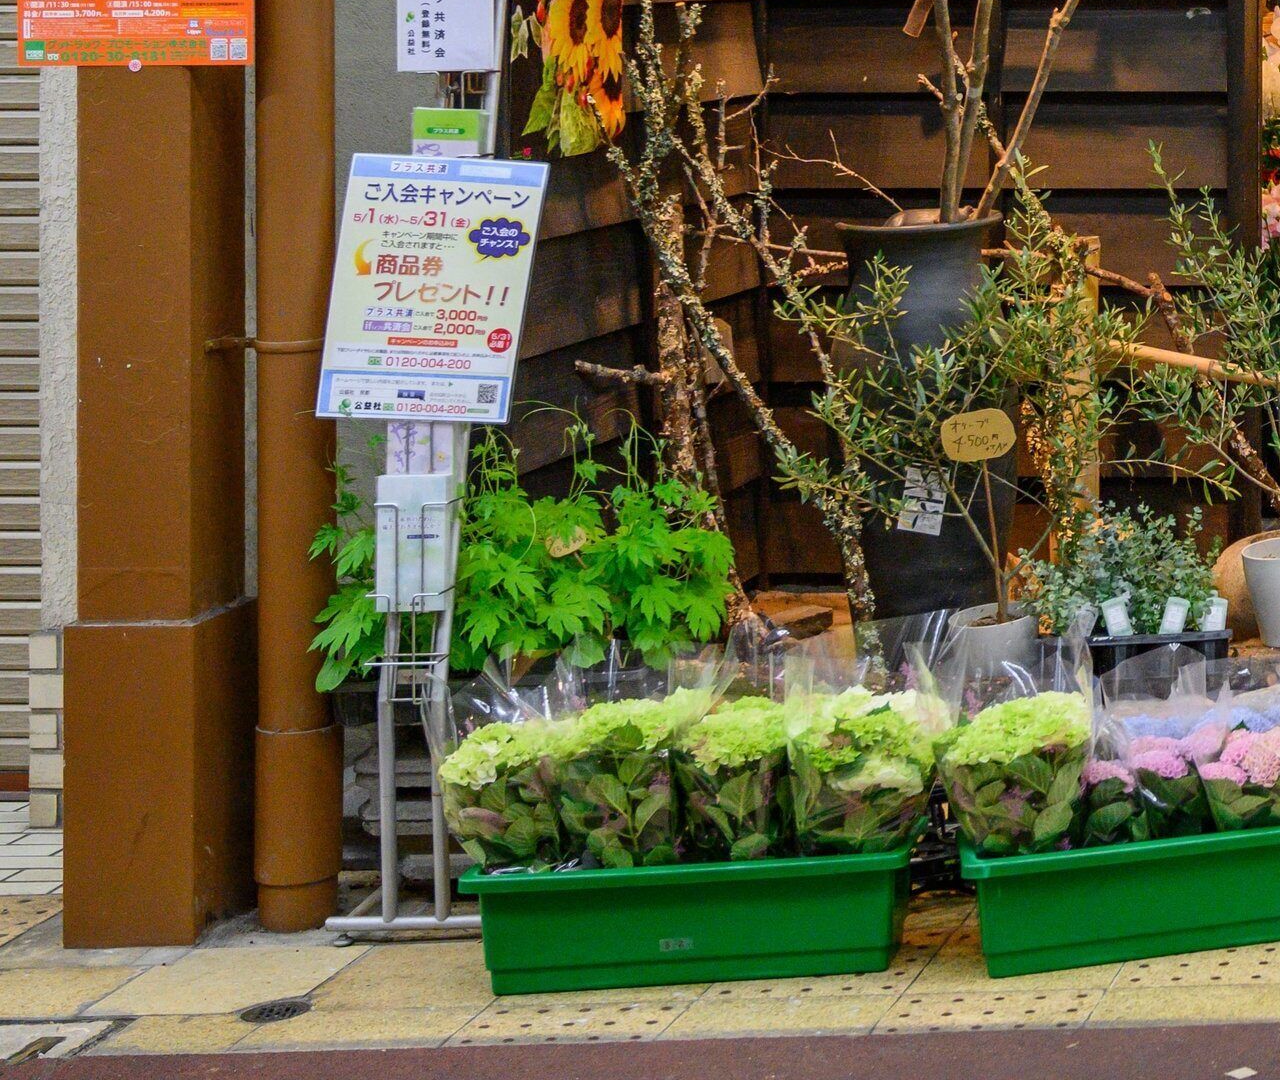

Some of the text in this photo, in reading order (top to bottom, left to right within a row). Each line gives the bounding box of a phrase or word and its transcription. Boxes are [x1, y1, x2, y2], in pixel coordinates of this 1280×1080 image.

[407, 29, 415, 56] 公益社
[392, 161, 448, 174] プラス共済
[364, 183, 531, 209] ご入会キャンペーン
[381, 231, 460, 242] キャンペーン期間中に
[482, 226, 518, 237] ご入会の
[375, 253, 443, 277] 商品券
[366, 306, 413, 317] プラス共済
[385, 356, 471, 370] 0120-004-200
[354, 401, 381, 411] 公益社
[396, 402, 467, 415] 0120-004-200
